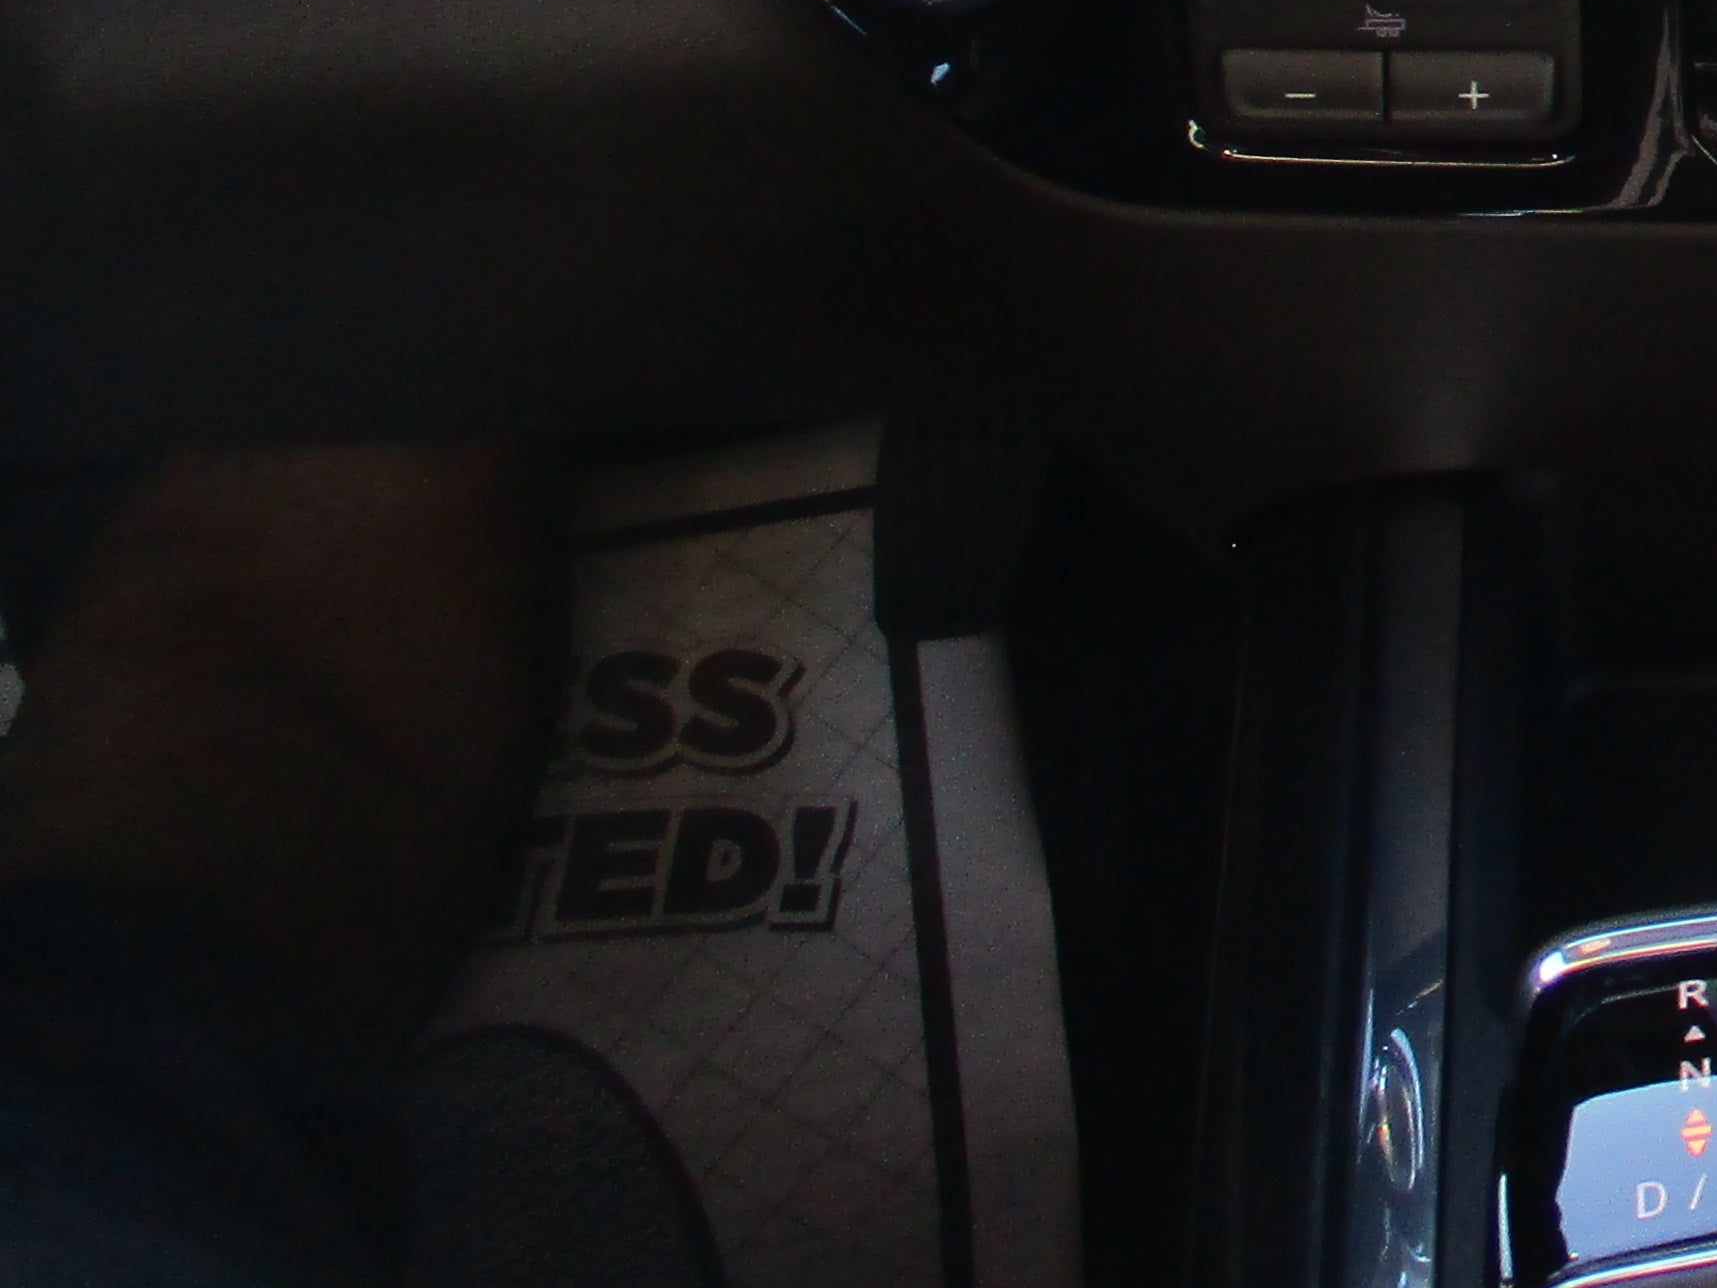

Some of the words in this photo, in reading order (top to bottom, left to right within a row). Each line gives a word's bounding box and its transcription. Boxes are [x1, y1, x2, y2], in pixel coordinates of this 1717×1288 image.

[1677, 981, 1708, 1009] R
[1678, 1059, 1711, 1091] N
[1636, 1181, 1667, 1219] D
